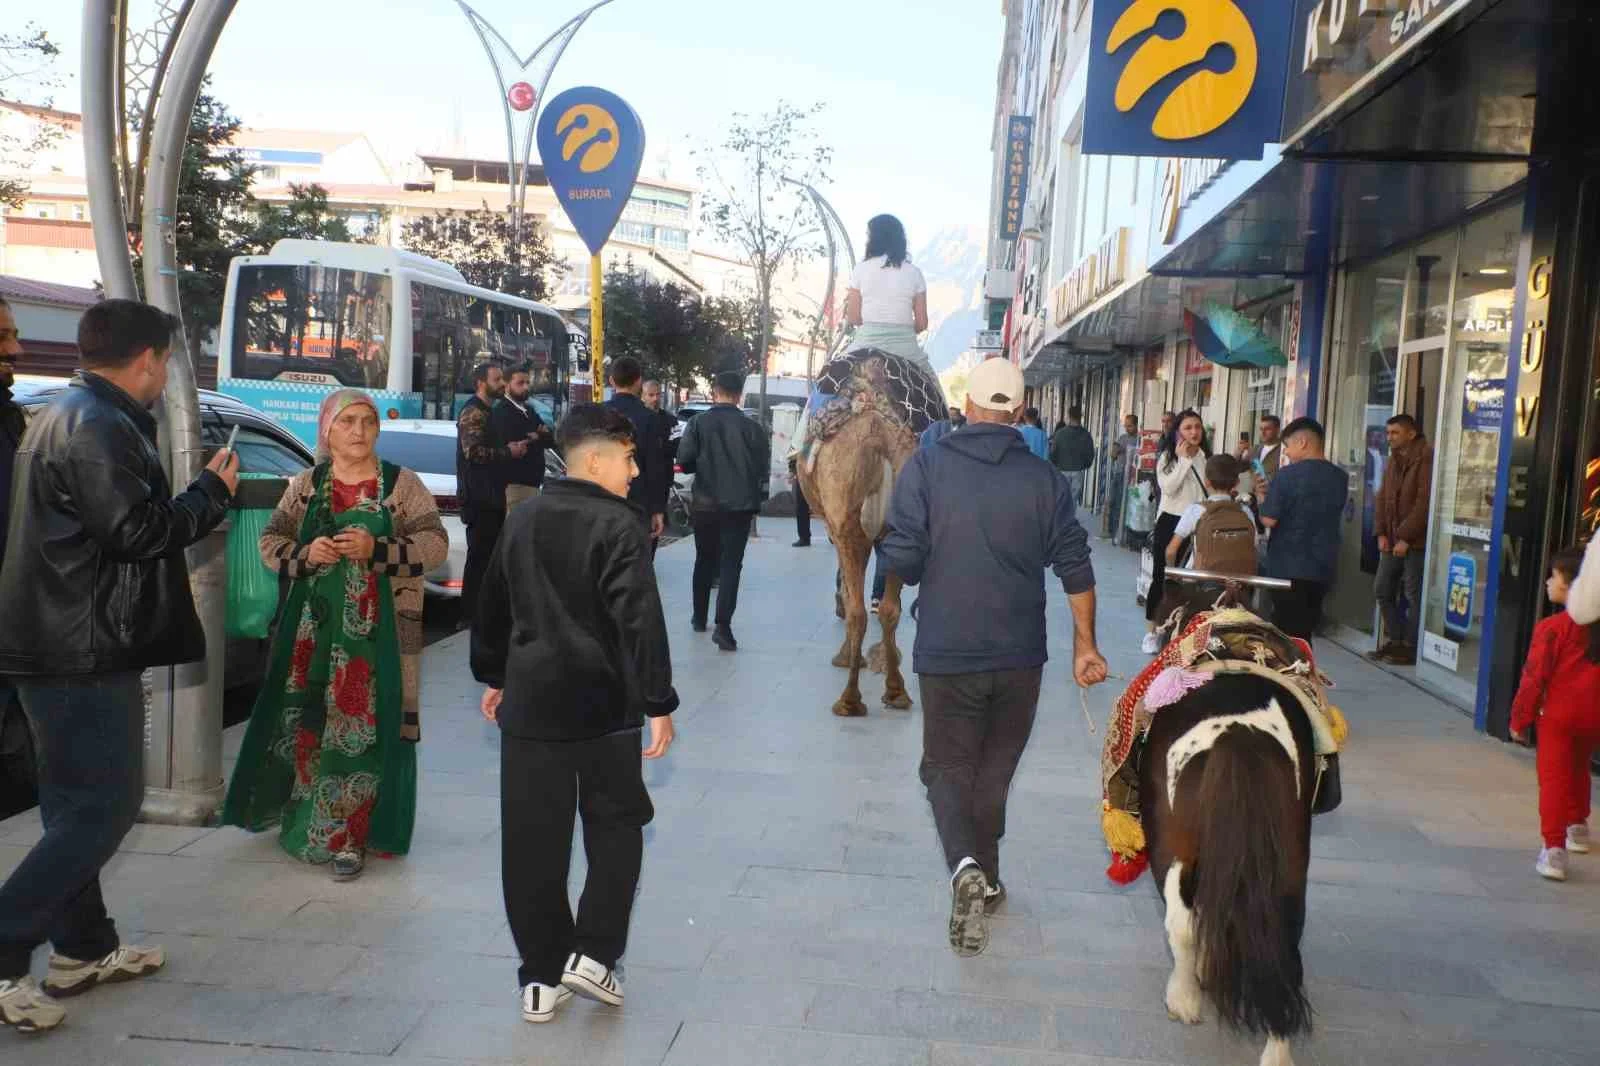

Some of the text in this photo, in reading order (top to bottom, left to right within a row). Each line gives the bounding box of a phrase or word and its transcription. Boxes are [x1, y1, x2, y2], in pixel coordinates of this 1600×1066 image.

[1302, 0, 1368, 72] KU
[568, 187, 611, 200] BURADA
[287, 372, 327, 383] ISUZU
